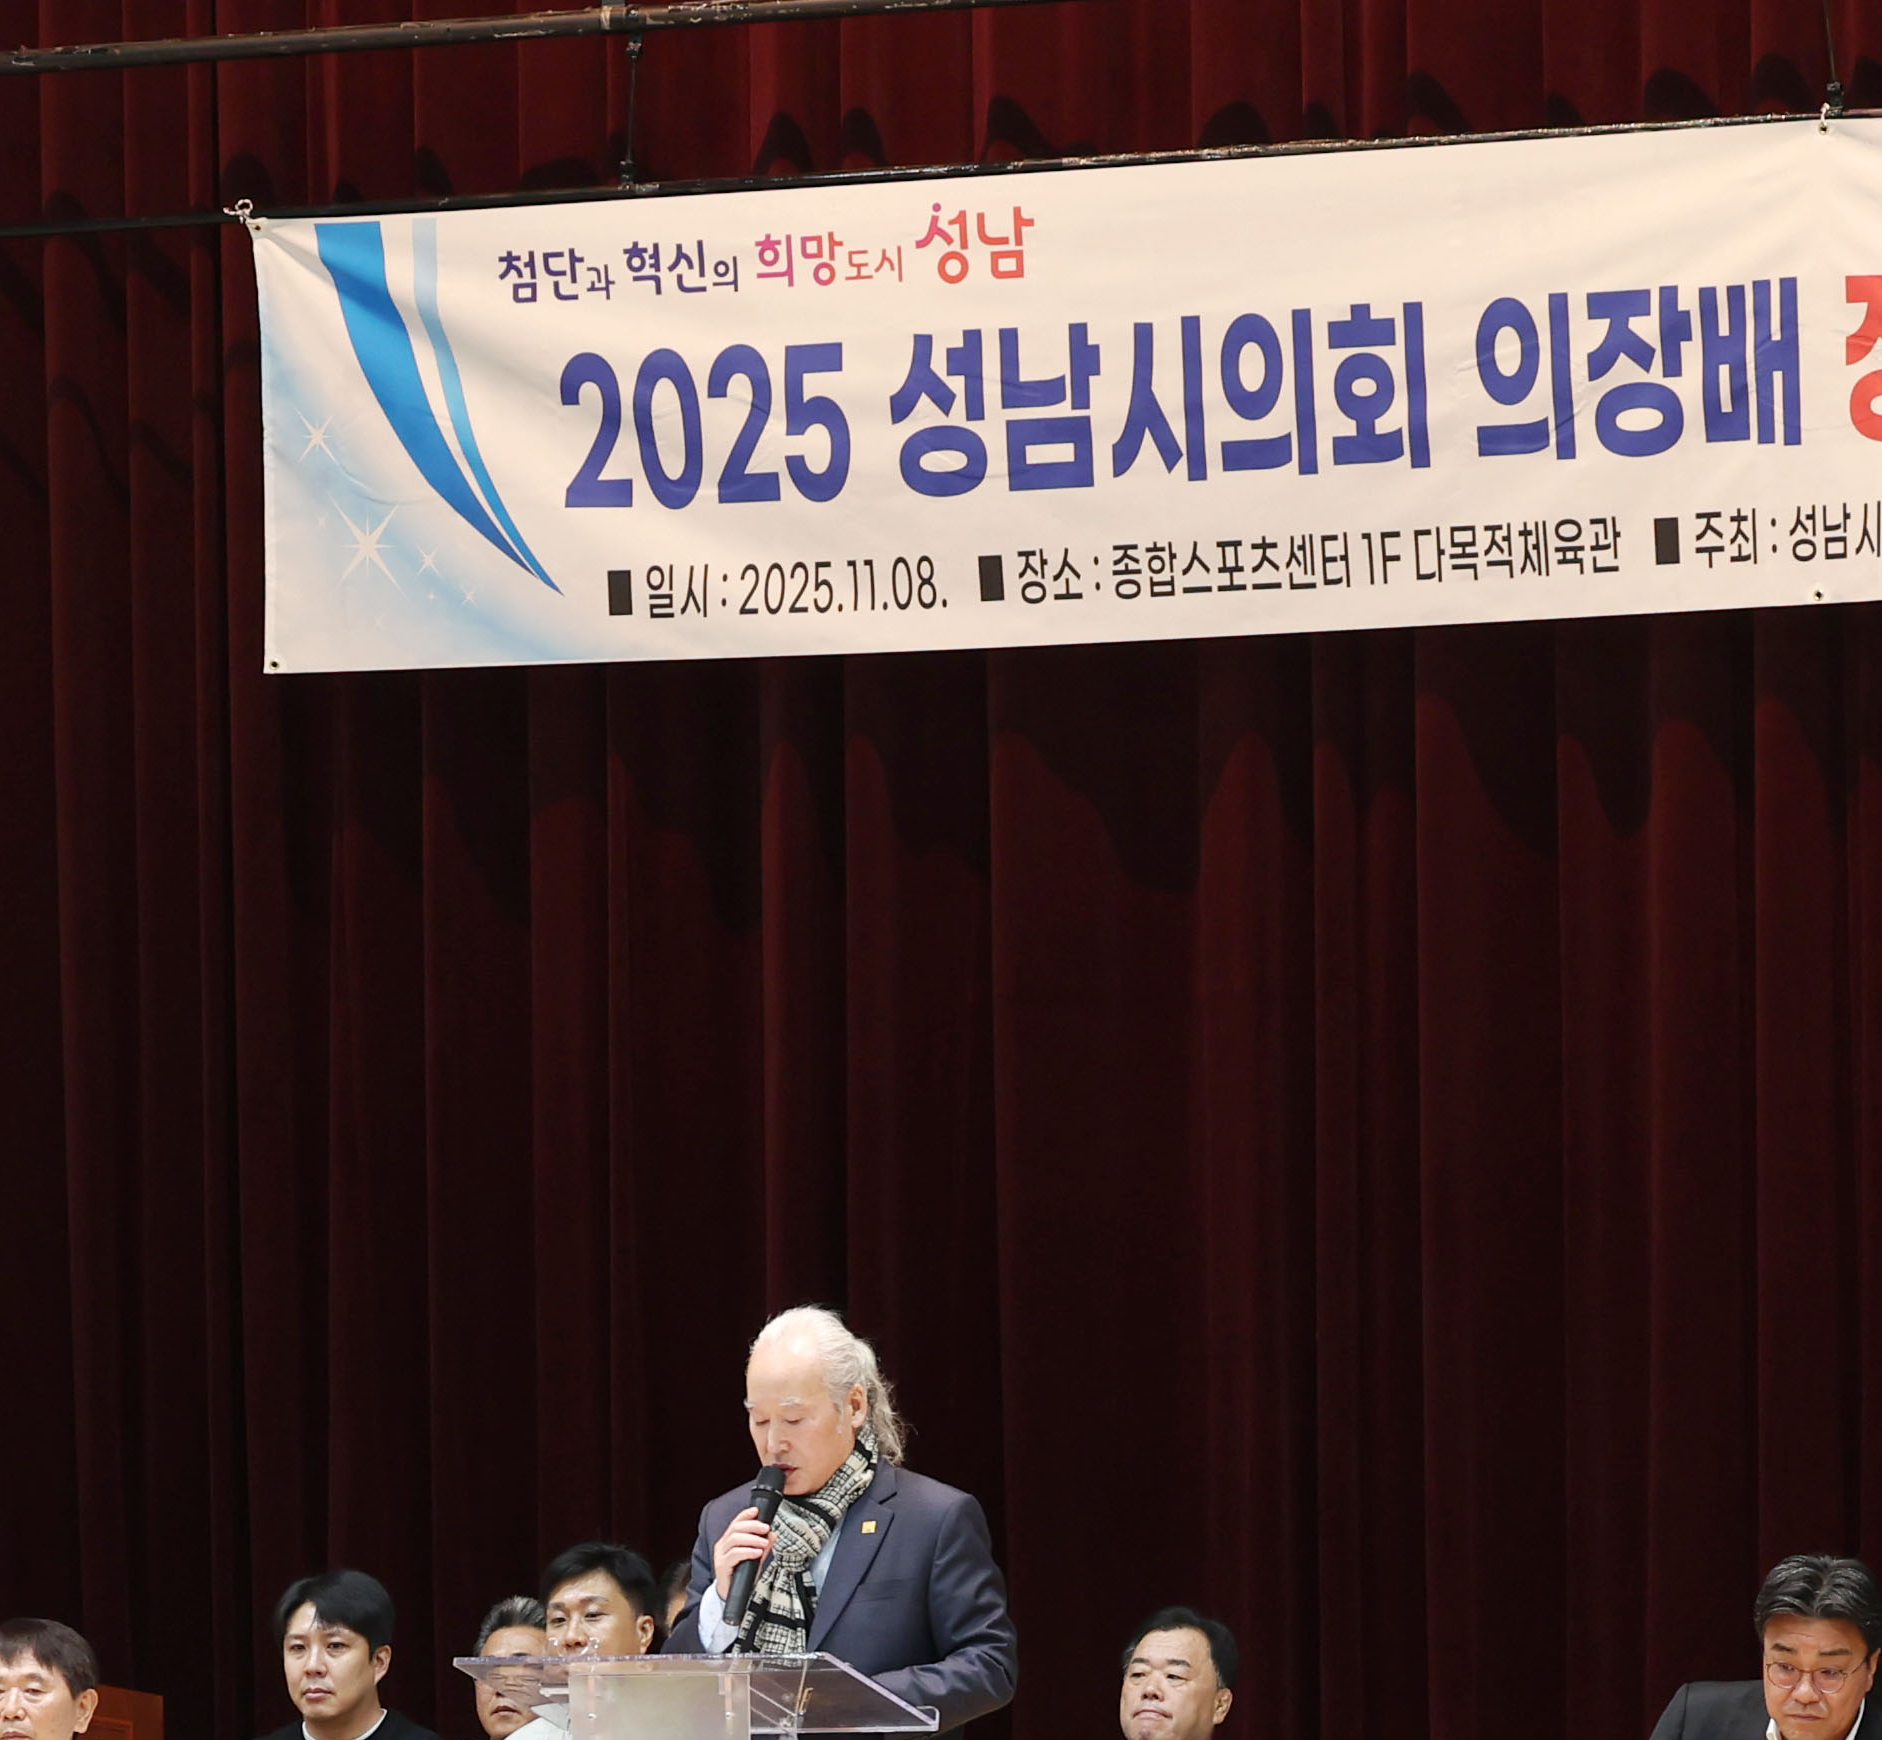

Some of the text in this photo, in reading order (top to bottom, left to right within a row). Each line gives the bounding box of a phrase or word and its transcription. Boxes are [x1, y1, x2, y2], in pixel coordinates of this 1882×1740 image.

[497, 202, 1035, 304] 첨단과 혁신의 희망도시 성남
[559, 341, 852, 510] 2025
[889, 301, 1433, 498] 성남시의회
[1474, 276, 1803, 461] 의장배
[1016, 547, 1084, 605] 장소
[1111, 531, 1351, 600] 종합스포츠센터
[1360, 530, 1402, 586] 1F
[1413, 515, 1622, 584] 다목적체육관
[1694, 507, 1758, 569] 주최
[645, 563, 709, 620] 일시
[738, 554, 948, 616] 2025.11.08.
